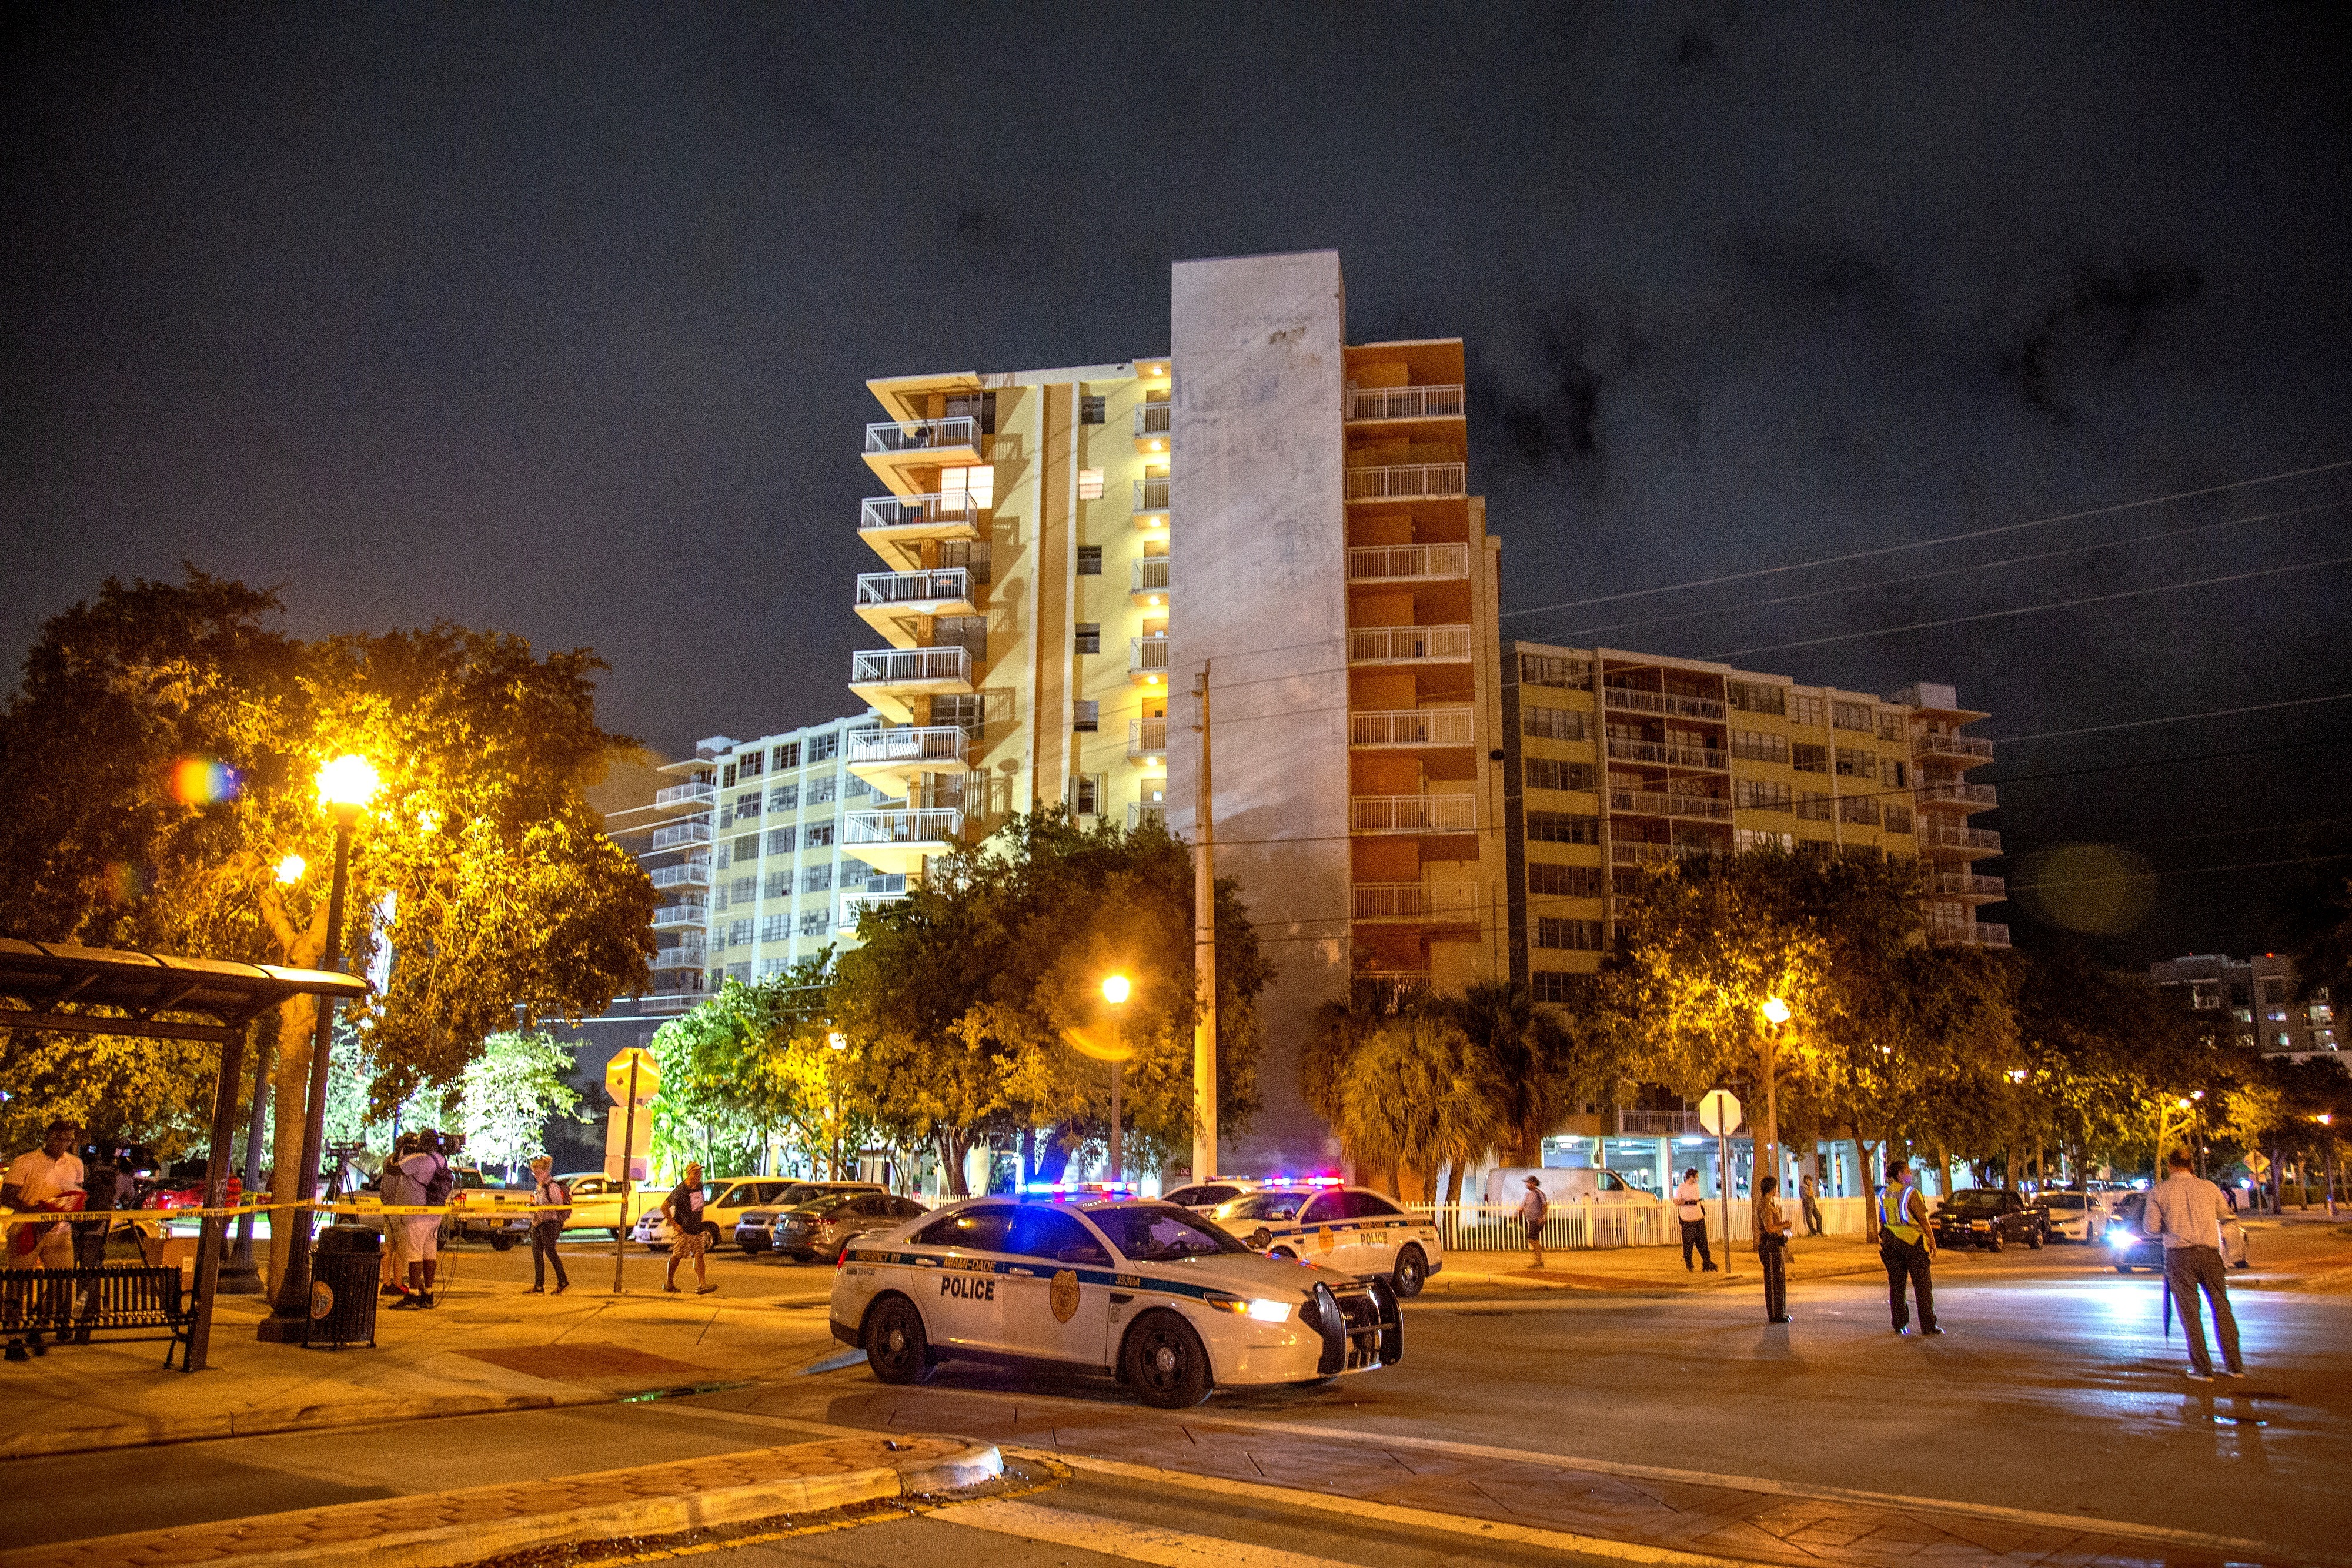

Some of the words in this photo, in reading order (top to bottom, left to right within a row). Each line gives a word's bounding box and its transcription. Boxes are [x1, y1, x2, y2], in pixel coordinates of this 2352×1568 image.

[40, 1214, 59, 1222] POLICE
[1360, 1231, 1388, 1246] POLICE
[856, 1250, 890, 1263] EMERGENCY
[890, 1252, 901, 1263] 911
[943, 1256, 996, 1272] MIAMI-DADE
[941, 1275, 995, 1302] POLICE
